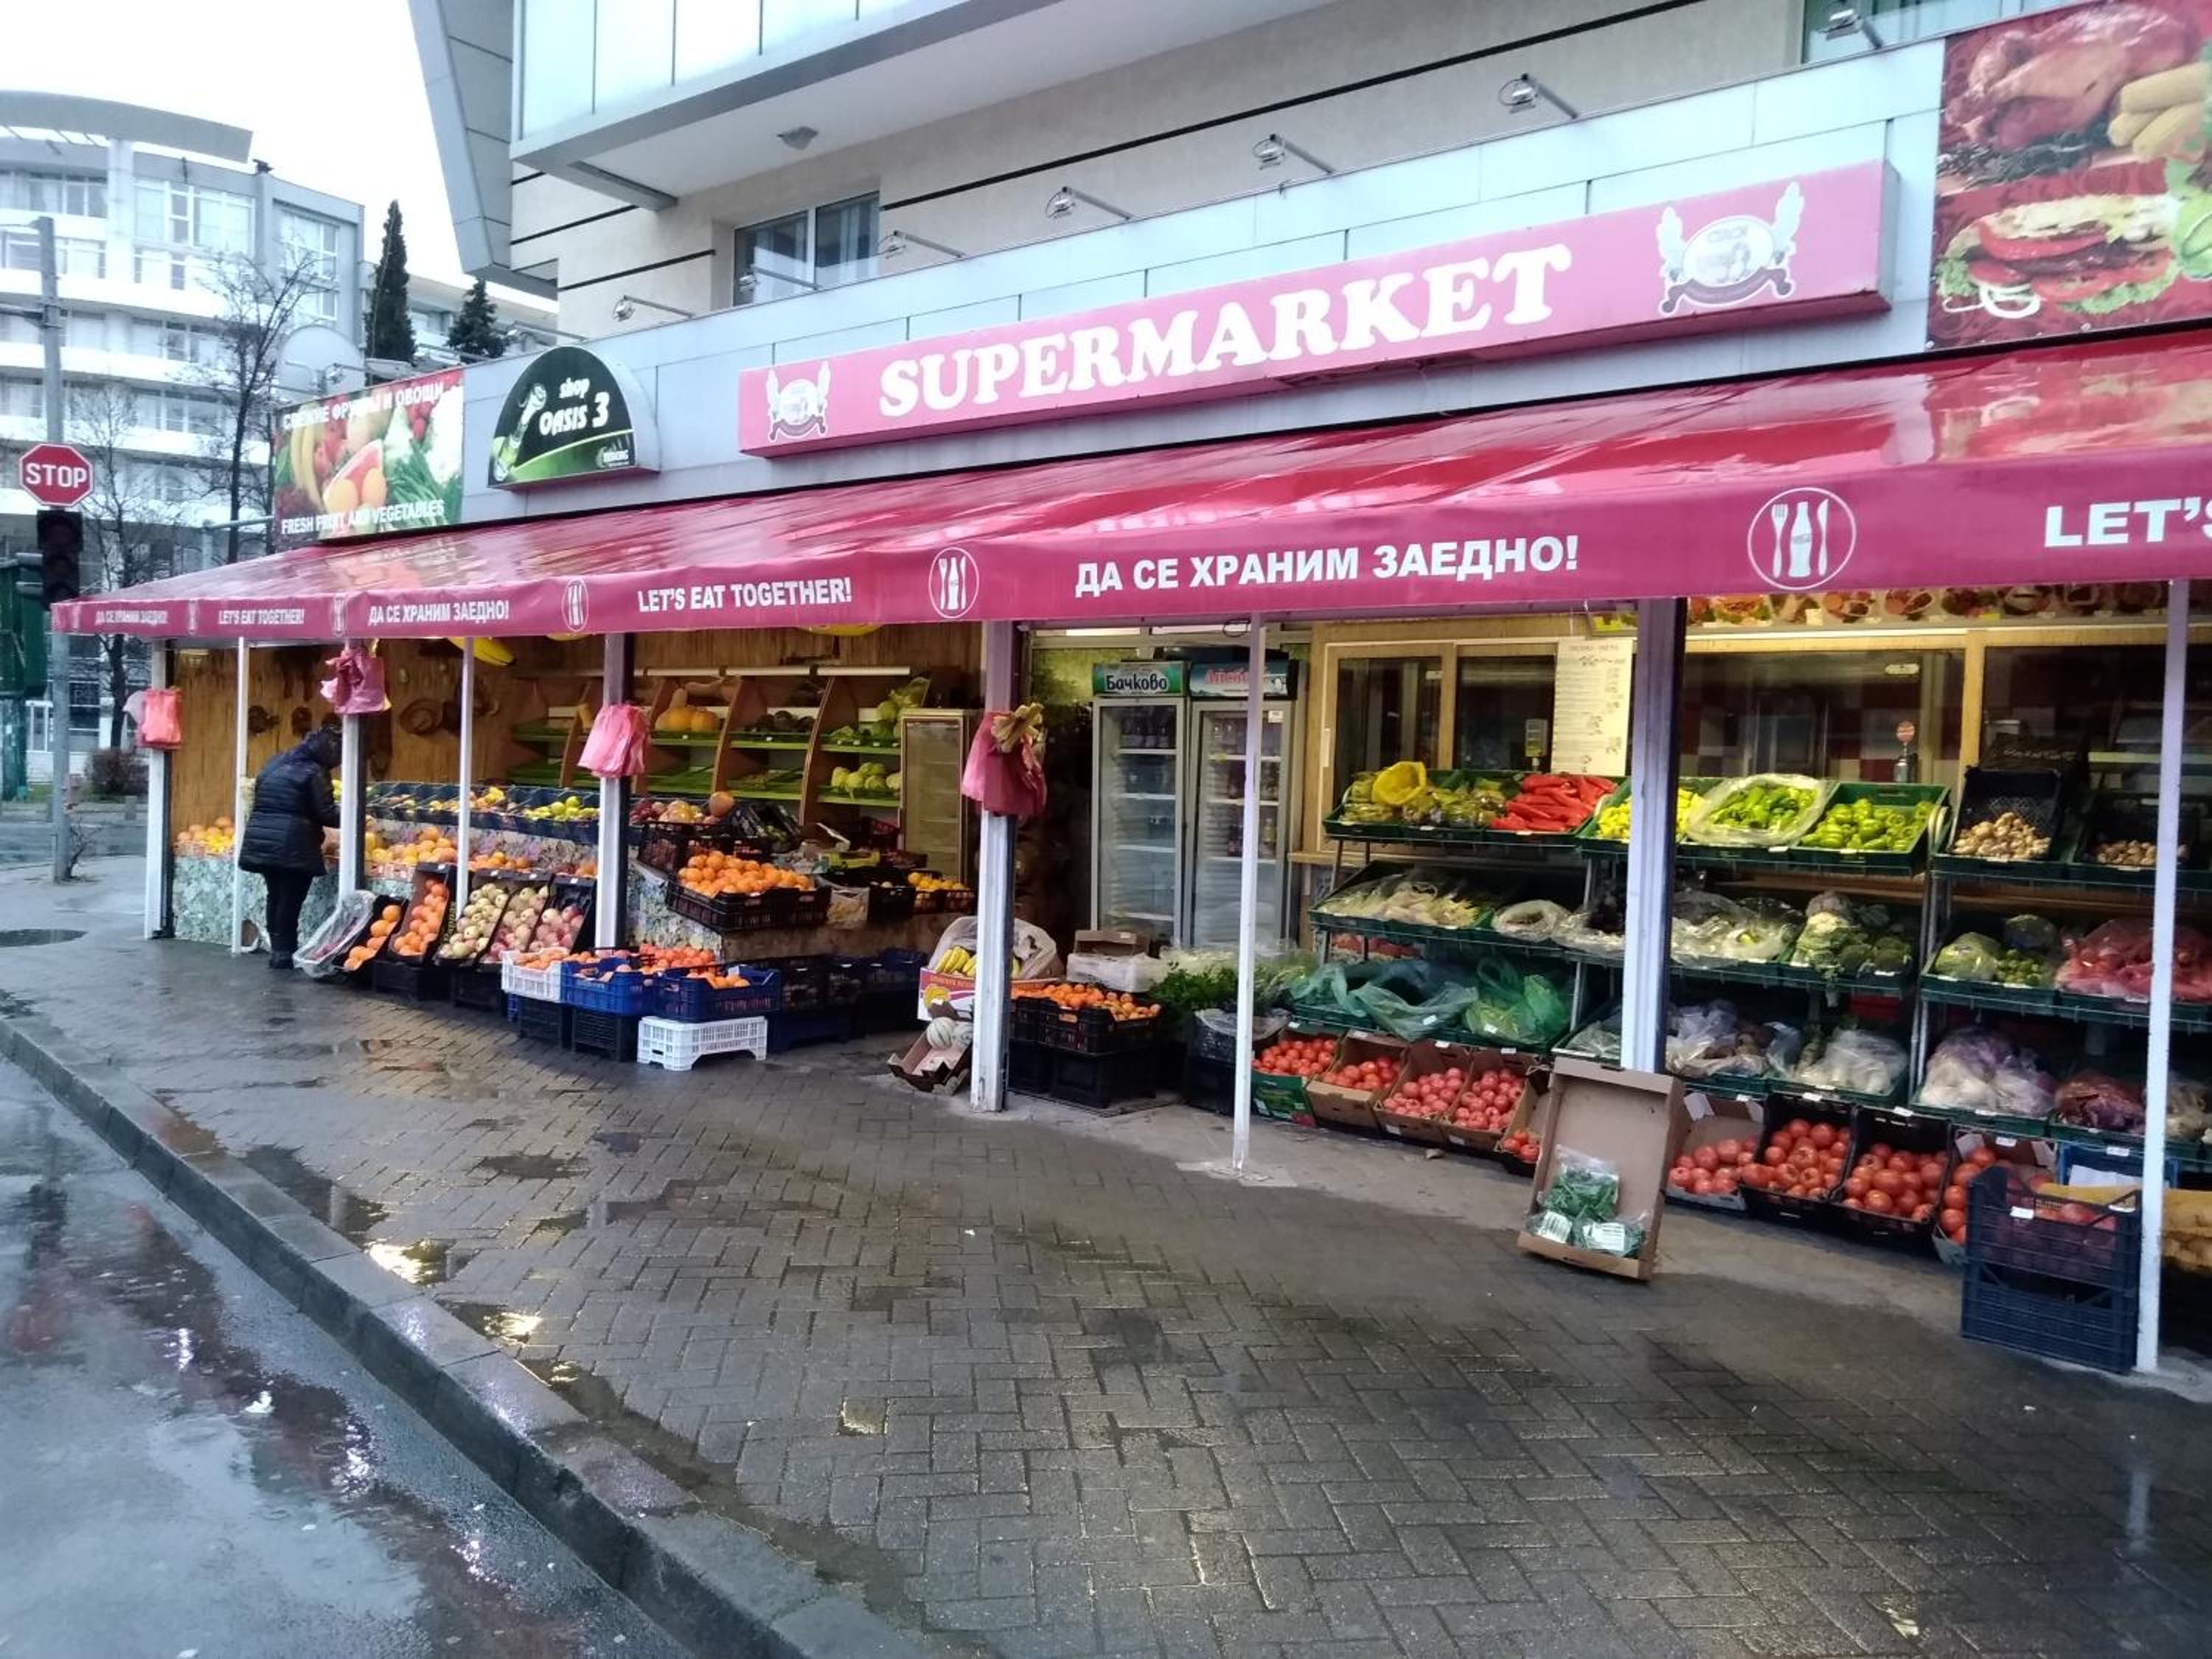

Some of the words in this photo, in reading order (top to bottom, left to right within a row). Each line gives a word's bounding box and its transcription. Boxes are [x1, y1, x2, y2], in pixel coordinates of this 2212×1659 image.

[880, 244, 1573, 417] SUPERMARKET
[558, 377, 590, 399] shop
[539, 405, 588, 436] OASIS
[592, 392, 610, 428] 3
[25, 462, 88, 488] STOP
[281, 515, 313, 535] FRESH
[375, 499, 445, 524] VEGETABLES
[2044, 496, 2212, 548] LET'
[1074, 563, 1123, 598] ДА
[1133, 559, 1179, 590] СЕ
[1189, 548, 1359, 588] ХРАНИМ
[1374, 535, 1579, 582] ЗАЕДНО!
[638, 587, 686, 612] LET'S
[690, 585, 726, 610] EAT
[730, 577, 852, 608] TOGETHER!
[369, 605, 385, 626] ДА
[386, 605, 401, 623] СЕ
[402, 602, 451, 623] ХРАНИМ
[453, 599, 509, 624] ЗАЕДНО!
[1106, 672, 1168, 691] Бачково
